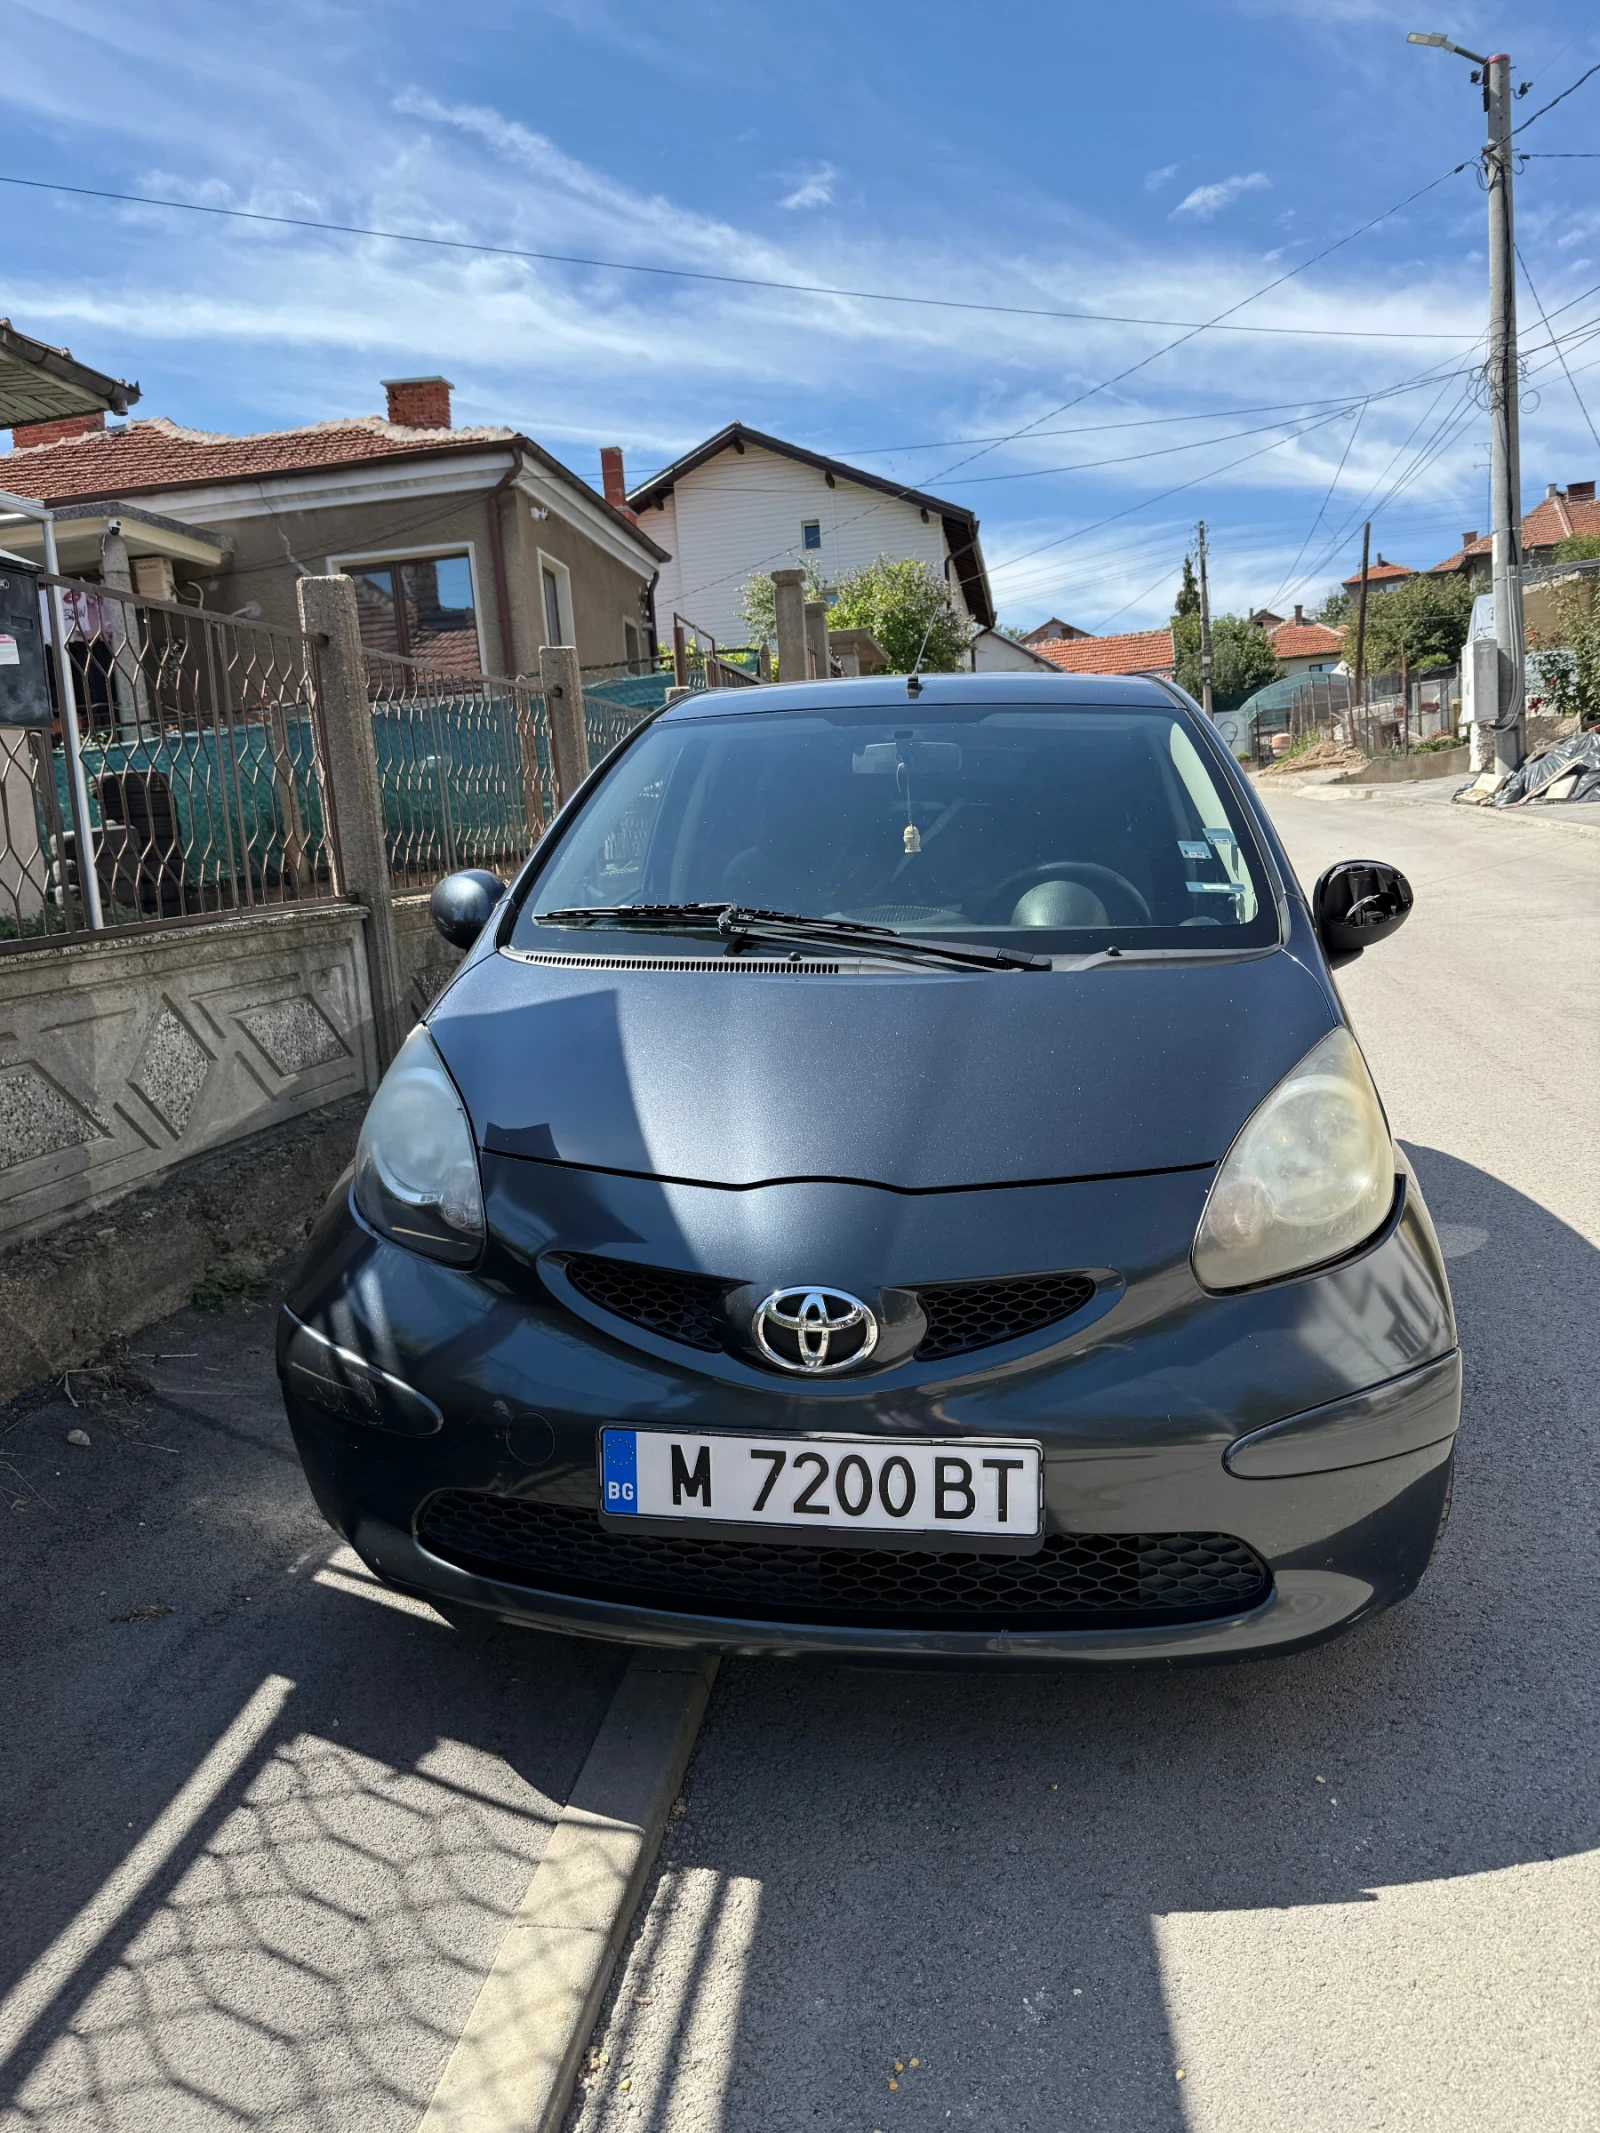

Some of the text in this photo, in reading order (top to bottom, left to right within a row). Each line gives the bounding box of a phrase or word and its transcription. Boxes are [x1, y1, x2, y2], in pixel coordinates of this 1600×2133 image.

[607, 1481, 635, 1501] BG
[670, 1443, 1024, 1523] M 7200 BT
